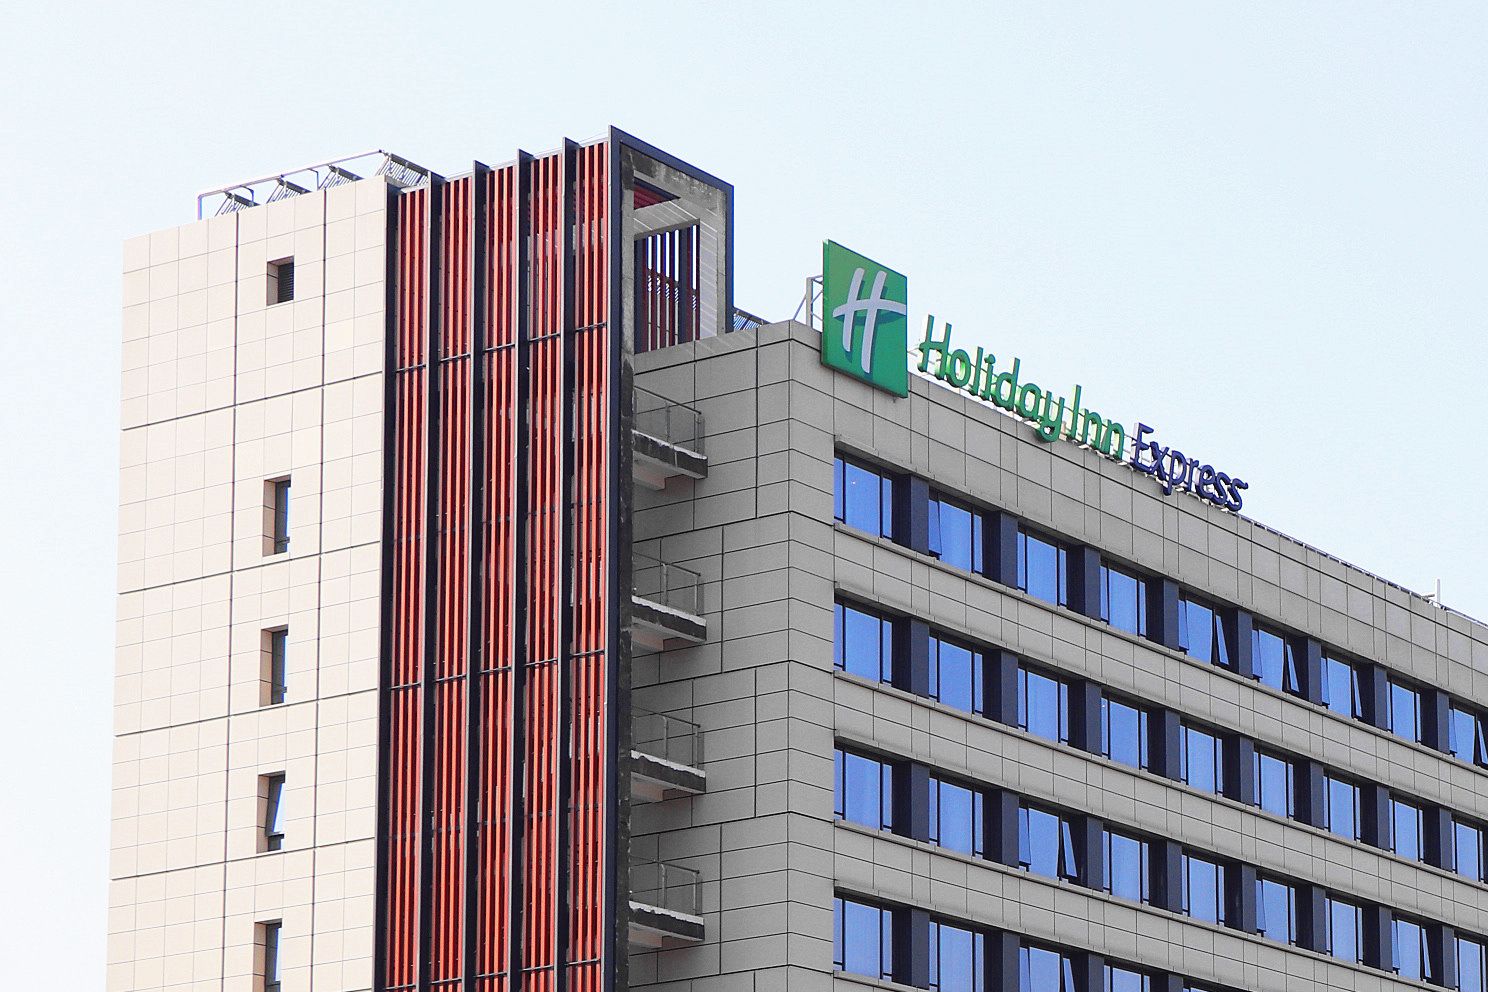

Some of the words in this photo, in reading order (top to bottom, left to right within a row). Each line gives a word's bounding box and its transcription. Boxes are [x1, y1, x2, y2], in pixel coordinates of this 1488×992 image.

[833, 267, 906, 374] H
[917, 314, 1065, 443] Holiday
[1067, 384, 1125, 461] Inn
[1129, 422, 1249, 512] Express
